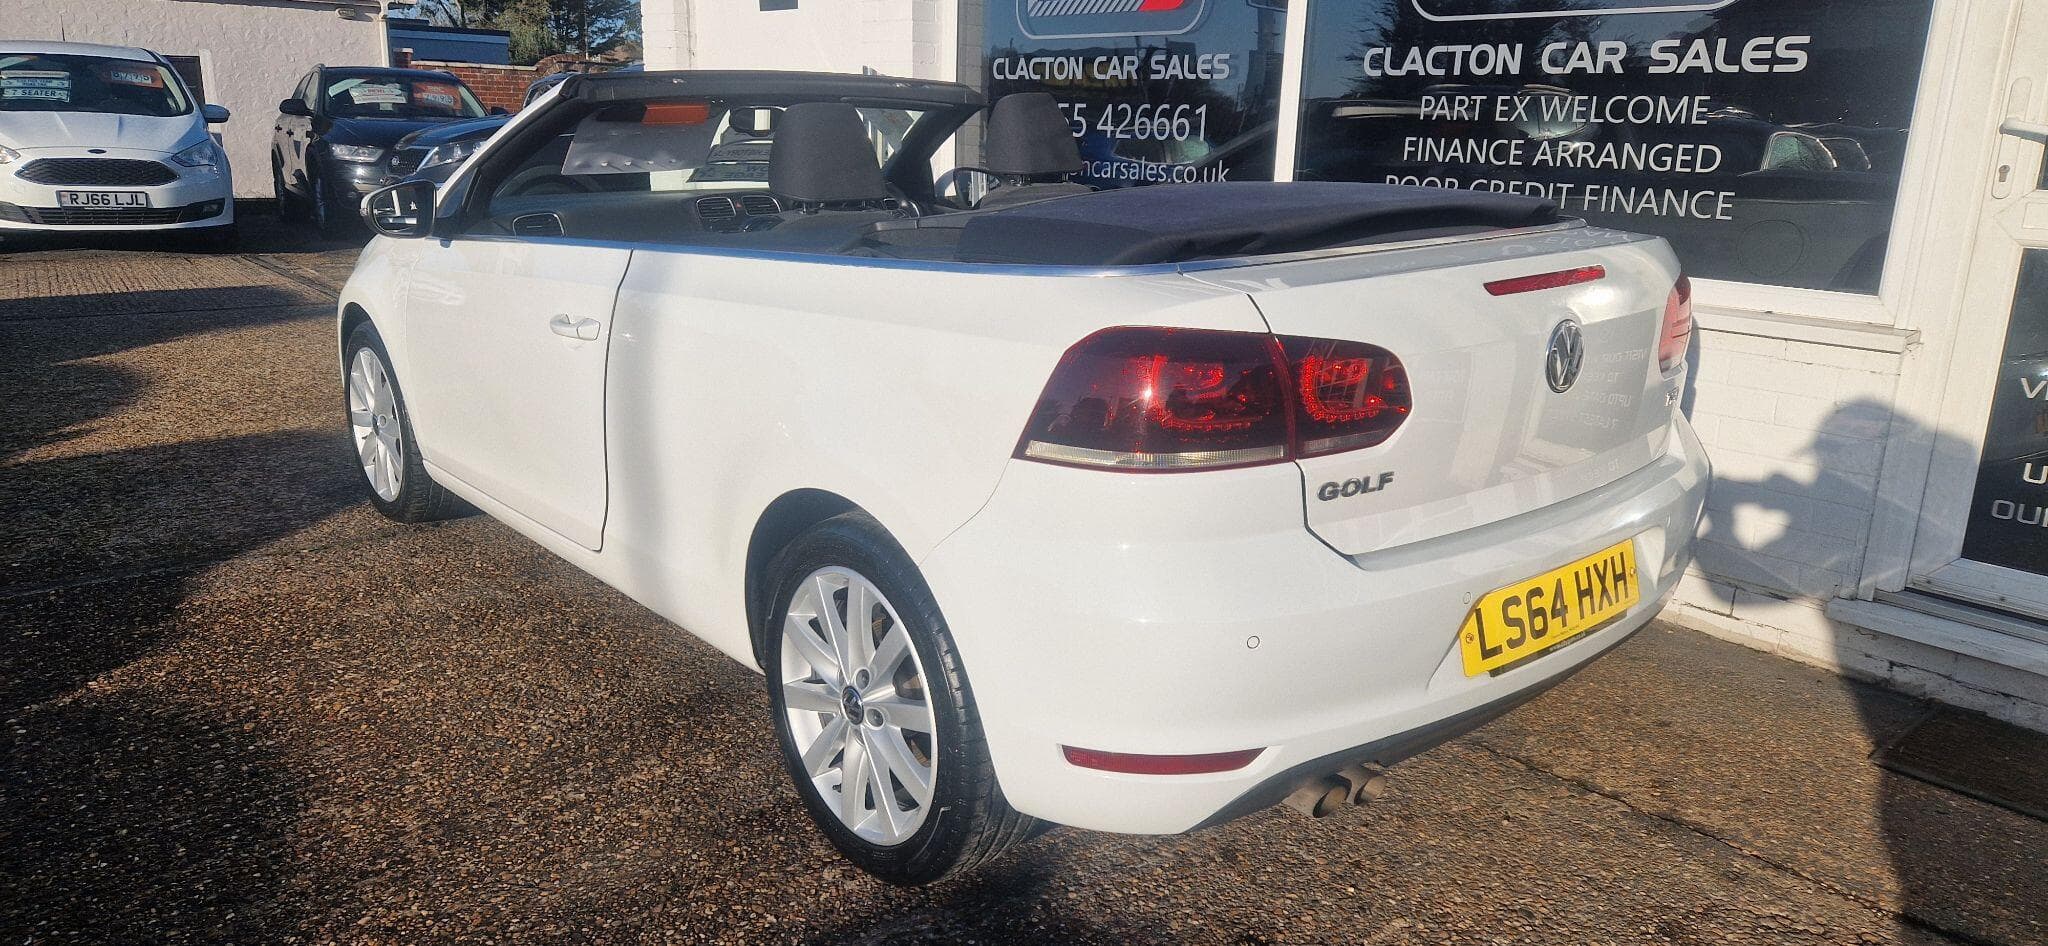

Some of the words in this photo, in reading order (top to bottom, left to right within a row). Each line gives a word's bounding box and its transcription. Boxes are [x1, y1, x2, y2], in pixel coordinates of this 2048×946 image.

[992, 56, 1083, 80] CLACTON
[1093, 54, 1138, 80] CAR
[1150, 53, 1231, 80] SALES
[1363, 42, 1523, 77] CLACTON
[1541, 40, 1628, 75] CAR
[1648, 35, 1811, 75] SALES
[21, 89, 57, 97] SEATER
[1096, 103, 1207, 142] 426661
[1419, 95, 1486, 121] PART
[1495, 95, 1532, 122] EX
[1539, 95, 1711, 125] WELCOME
[1069, 156, 1230, 183] ncarsales.co.uk
[1403, 136, 1523, 166] FINANCE
[1532, 140, 1722, 173] ARRANGED
[69, 193, 111, 206] RJ66
[114, 194, 145, 206] LJL
[1583, 184, 1735, 220] FINANCE
[2020, 377, 2048, 401] V
[1317, 471, 1395, 502] GOLF
[1475, 577, 1569, 661] LS64
[1574, 551, 1629, 621] HXH
